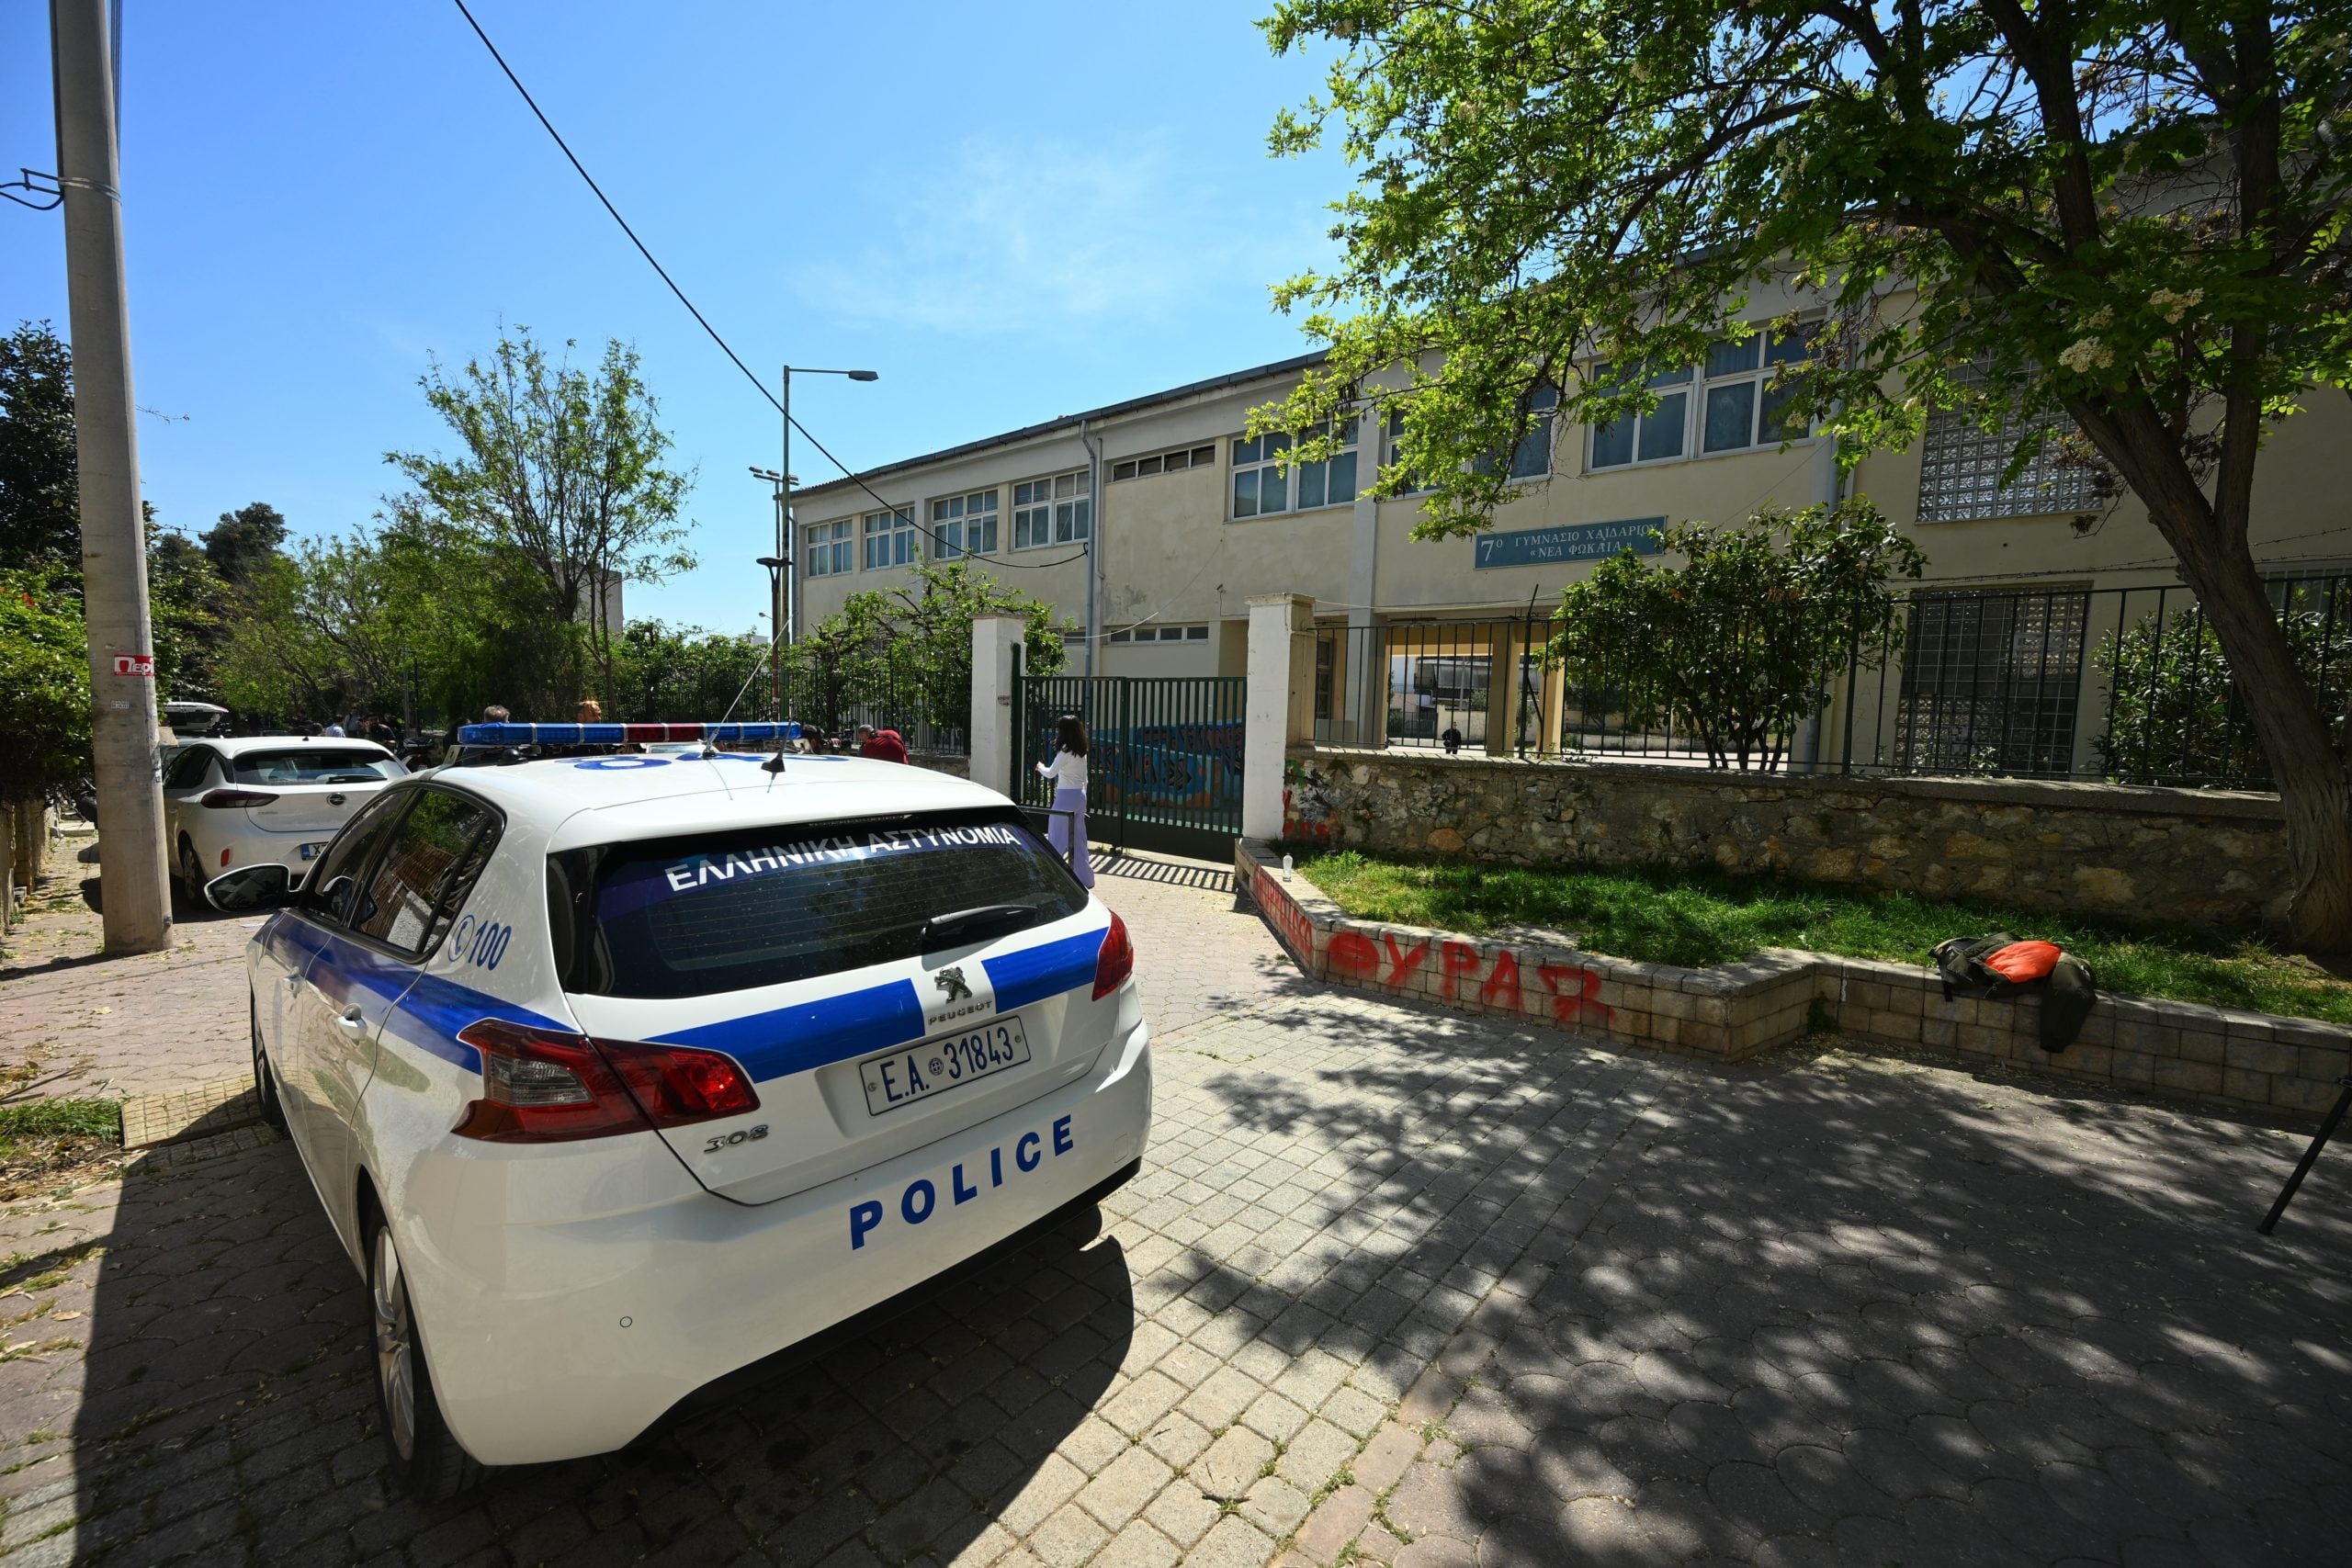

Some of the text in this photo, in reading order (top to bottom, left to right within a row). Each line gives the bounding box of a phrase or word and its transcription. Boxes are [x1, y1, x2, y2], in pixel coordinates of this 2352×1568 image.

[1515, 531, 1579, 547] ΓΥΜΝΑΣΙΟ
[665, 827, 1022, 892] ΕΛΛΗΝΙΚΗ ΑΣΤΥΝΟΜΙΑ
[468, 920, 512, 971] 100
[928, 1000, 993, 1026] PEUGEOT
[944, 1026, 1013, 1079] 31843
[704, 1124, 768, 1154] 308
[850, 1114, 1073, 1250] POLICE
